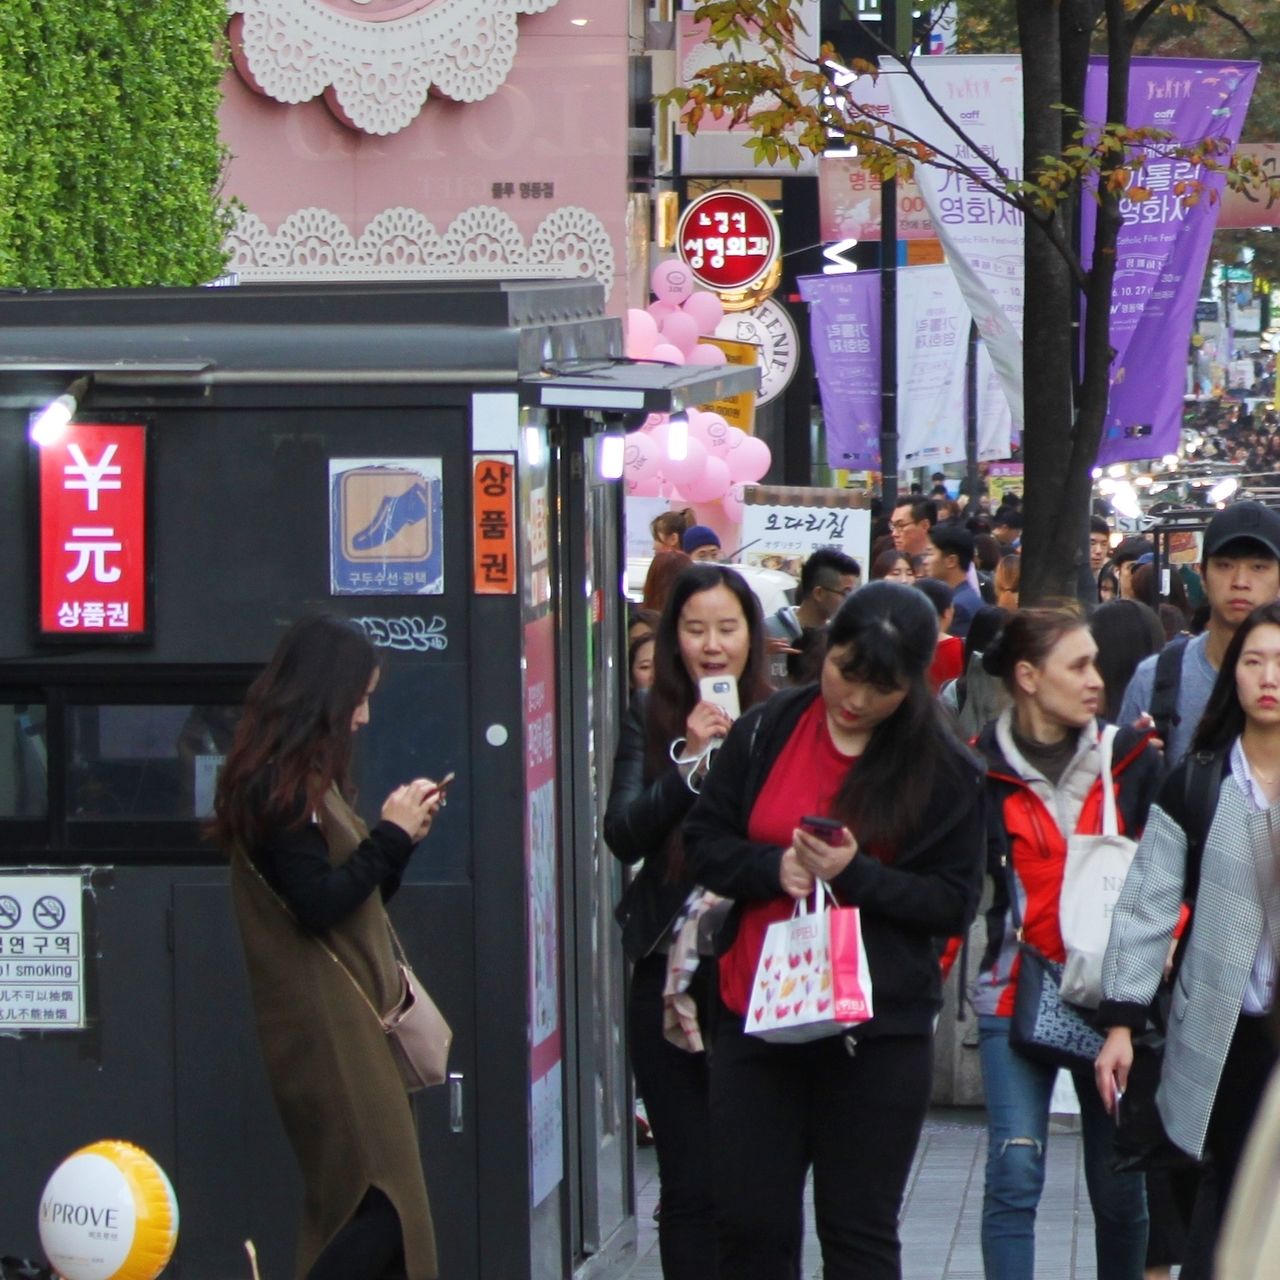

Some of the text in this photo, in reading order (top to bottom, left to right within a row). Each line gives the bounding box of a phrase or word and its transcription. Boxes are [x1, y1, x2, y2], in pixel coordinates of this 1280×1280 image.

[684, 236, 769, 269] 성형외과
[479, 466, 512, 585] 상품권
[764, 511, 849, 540] 오다리집
[64, 527, 122, 584] 元
[57, 602, 130, 629] 상품권
[15, 963, 73, 978] smoking
